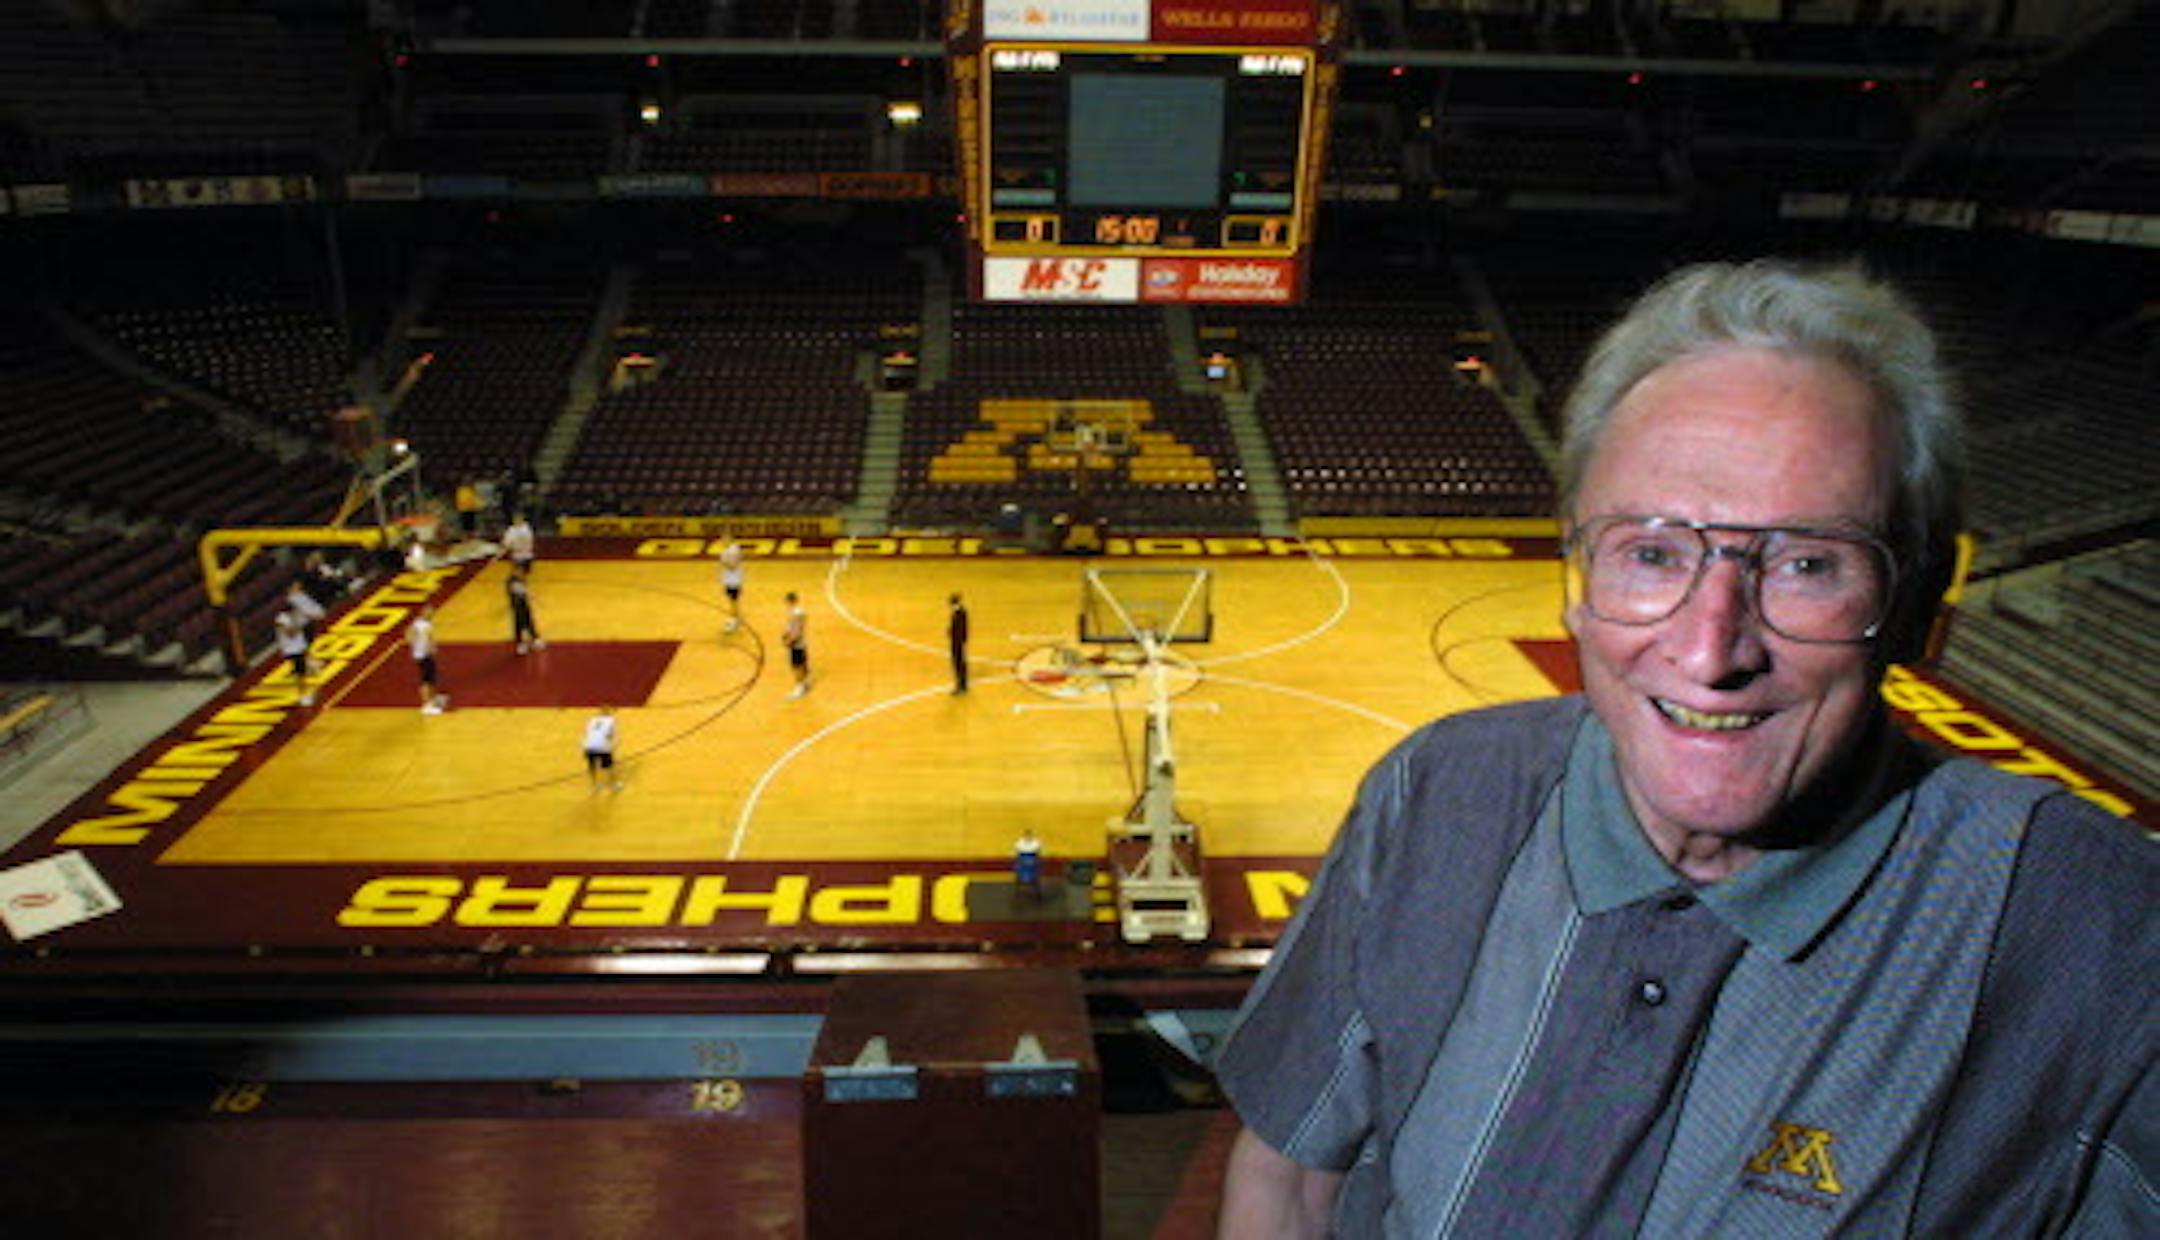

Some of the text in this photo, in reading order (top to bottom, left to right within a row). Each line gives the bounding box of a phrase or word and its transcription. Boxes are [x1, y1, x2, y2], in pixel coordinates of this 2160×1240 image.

[1199, 261, 1281, 288] Holiday
[54, 565, 464, 846] MINNESOTA
[690, 1079, 743, 1112] 19
